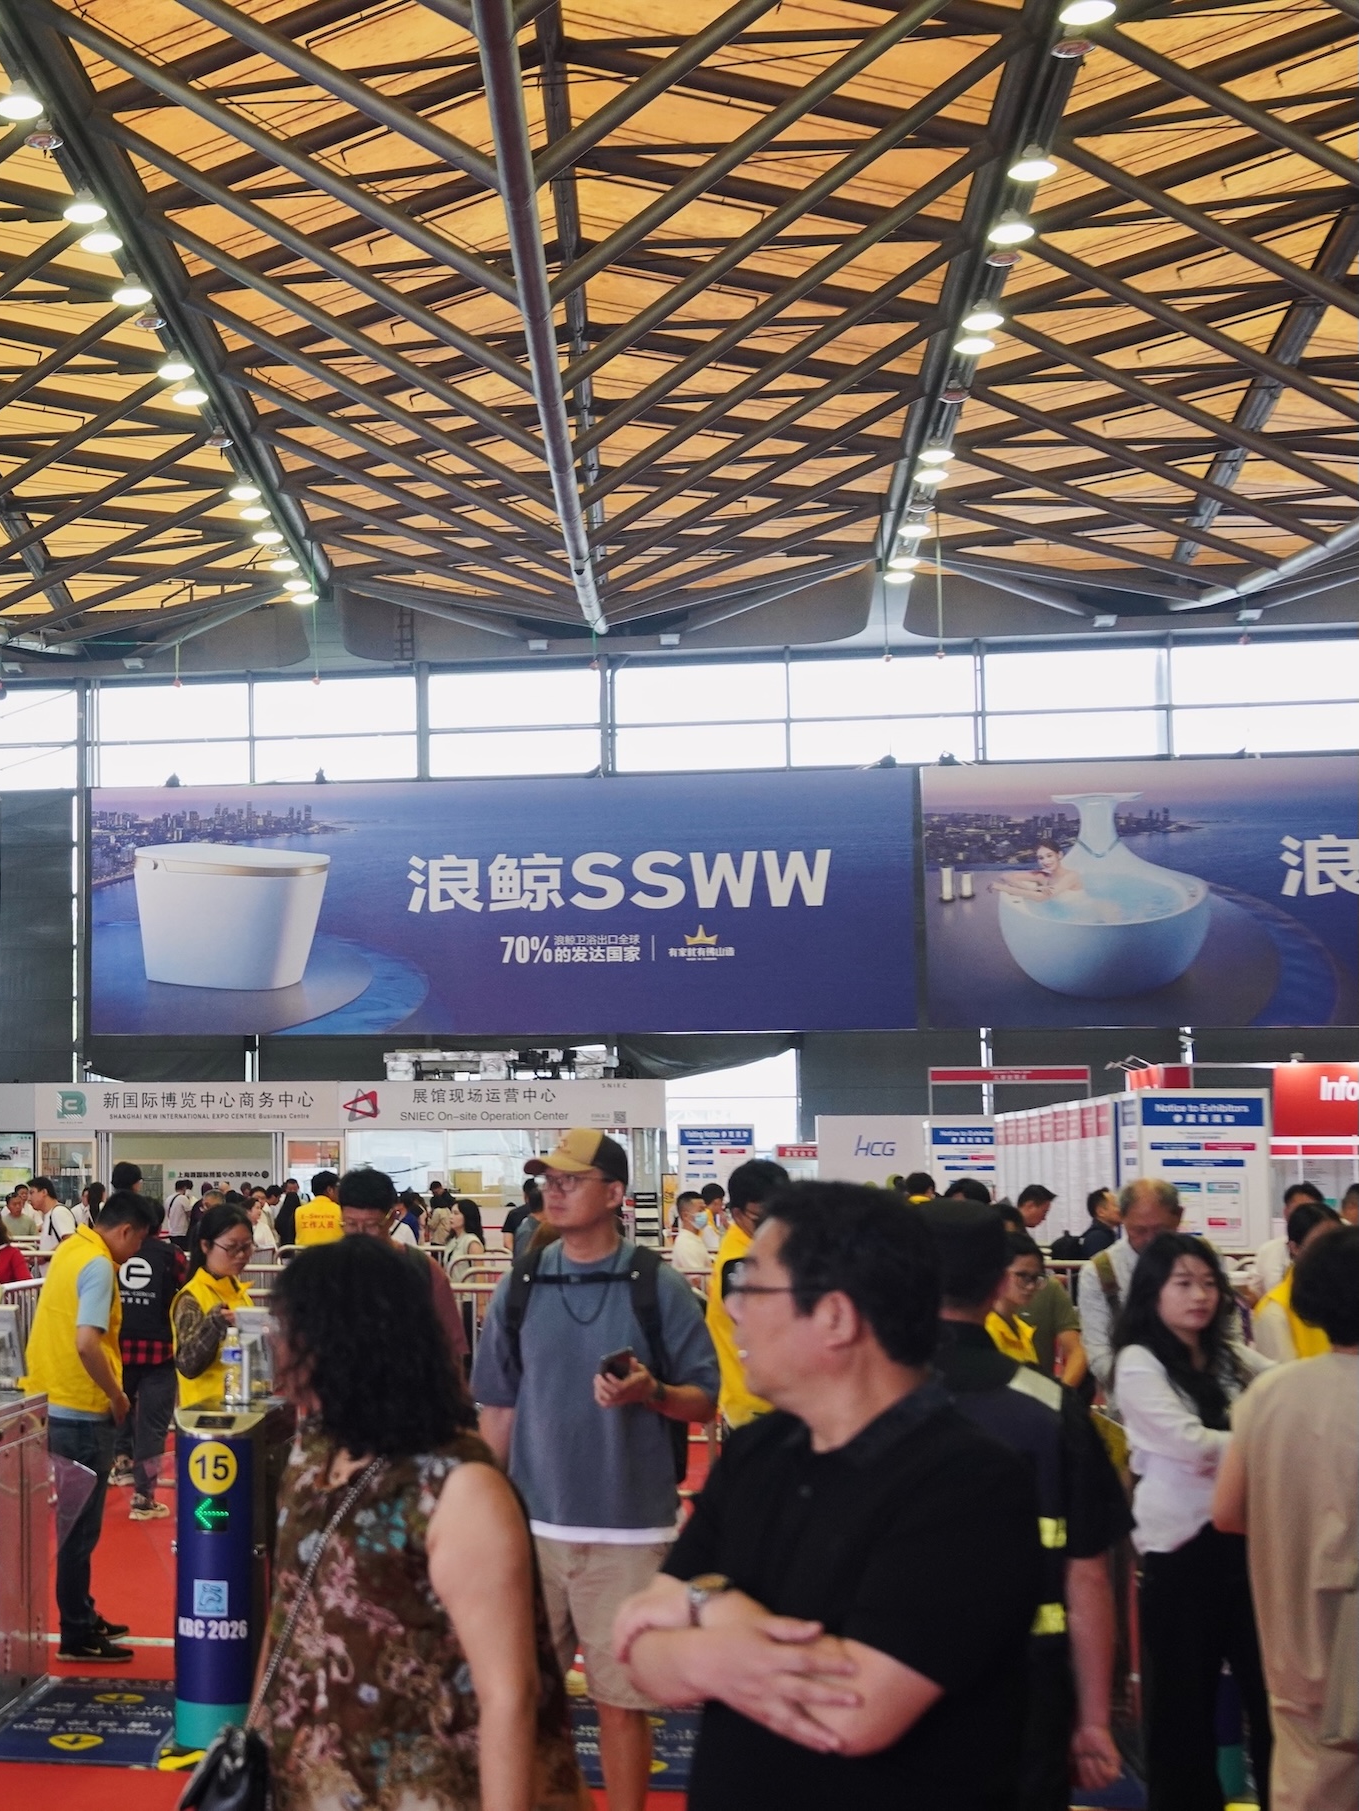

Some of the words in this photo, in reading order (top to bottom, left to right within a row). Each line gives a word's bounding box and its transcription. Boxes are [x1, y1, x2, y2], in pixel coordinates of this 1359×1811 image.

[1279, 834, 1359, 897] 浪
[500, 935, 552, 964] 70%
[554, 946, 640, 963] 的发达国家
[103, 1091, 314, 1109] 新国际博览中心商务中心
[412, 1088, 556, 1104] 展馆现场运营中心
[258, 1112, 288, 1120] Business
[400, 1112, 435, 1121] SNIEC
[437, 1111, 477, 1121] On-site
[480, 1111, 536, 1122] Operation
[538, 1110, 569, 1121] Center
[1154, 1103, 1187, 1112] Notice
[1199, 1103, 1250, 1113] Exhibitors
[854, 1135, 896, 1156] HCG
[301, 1221, 334, 1229] 工作人员
[194, 1455, 229, 1481] 15
[207, 1619, 248, 1640] 2026
